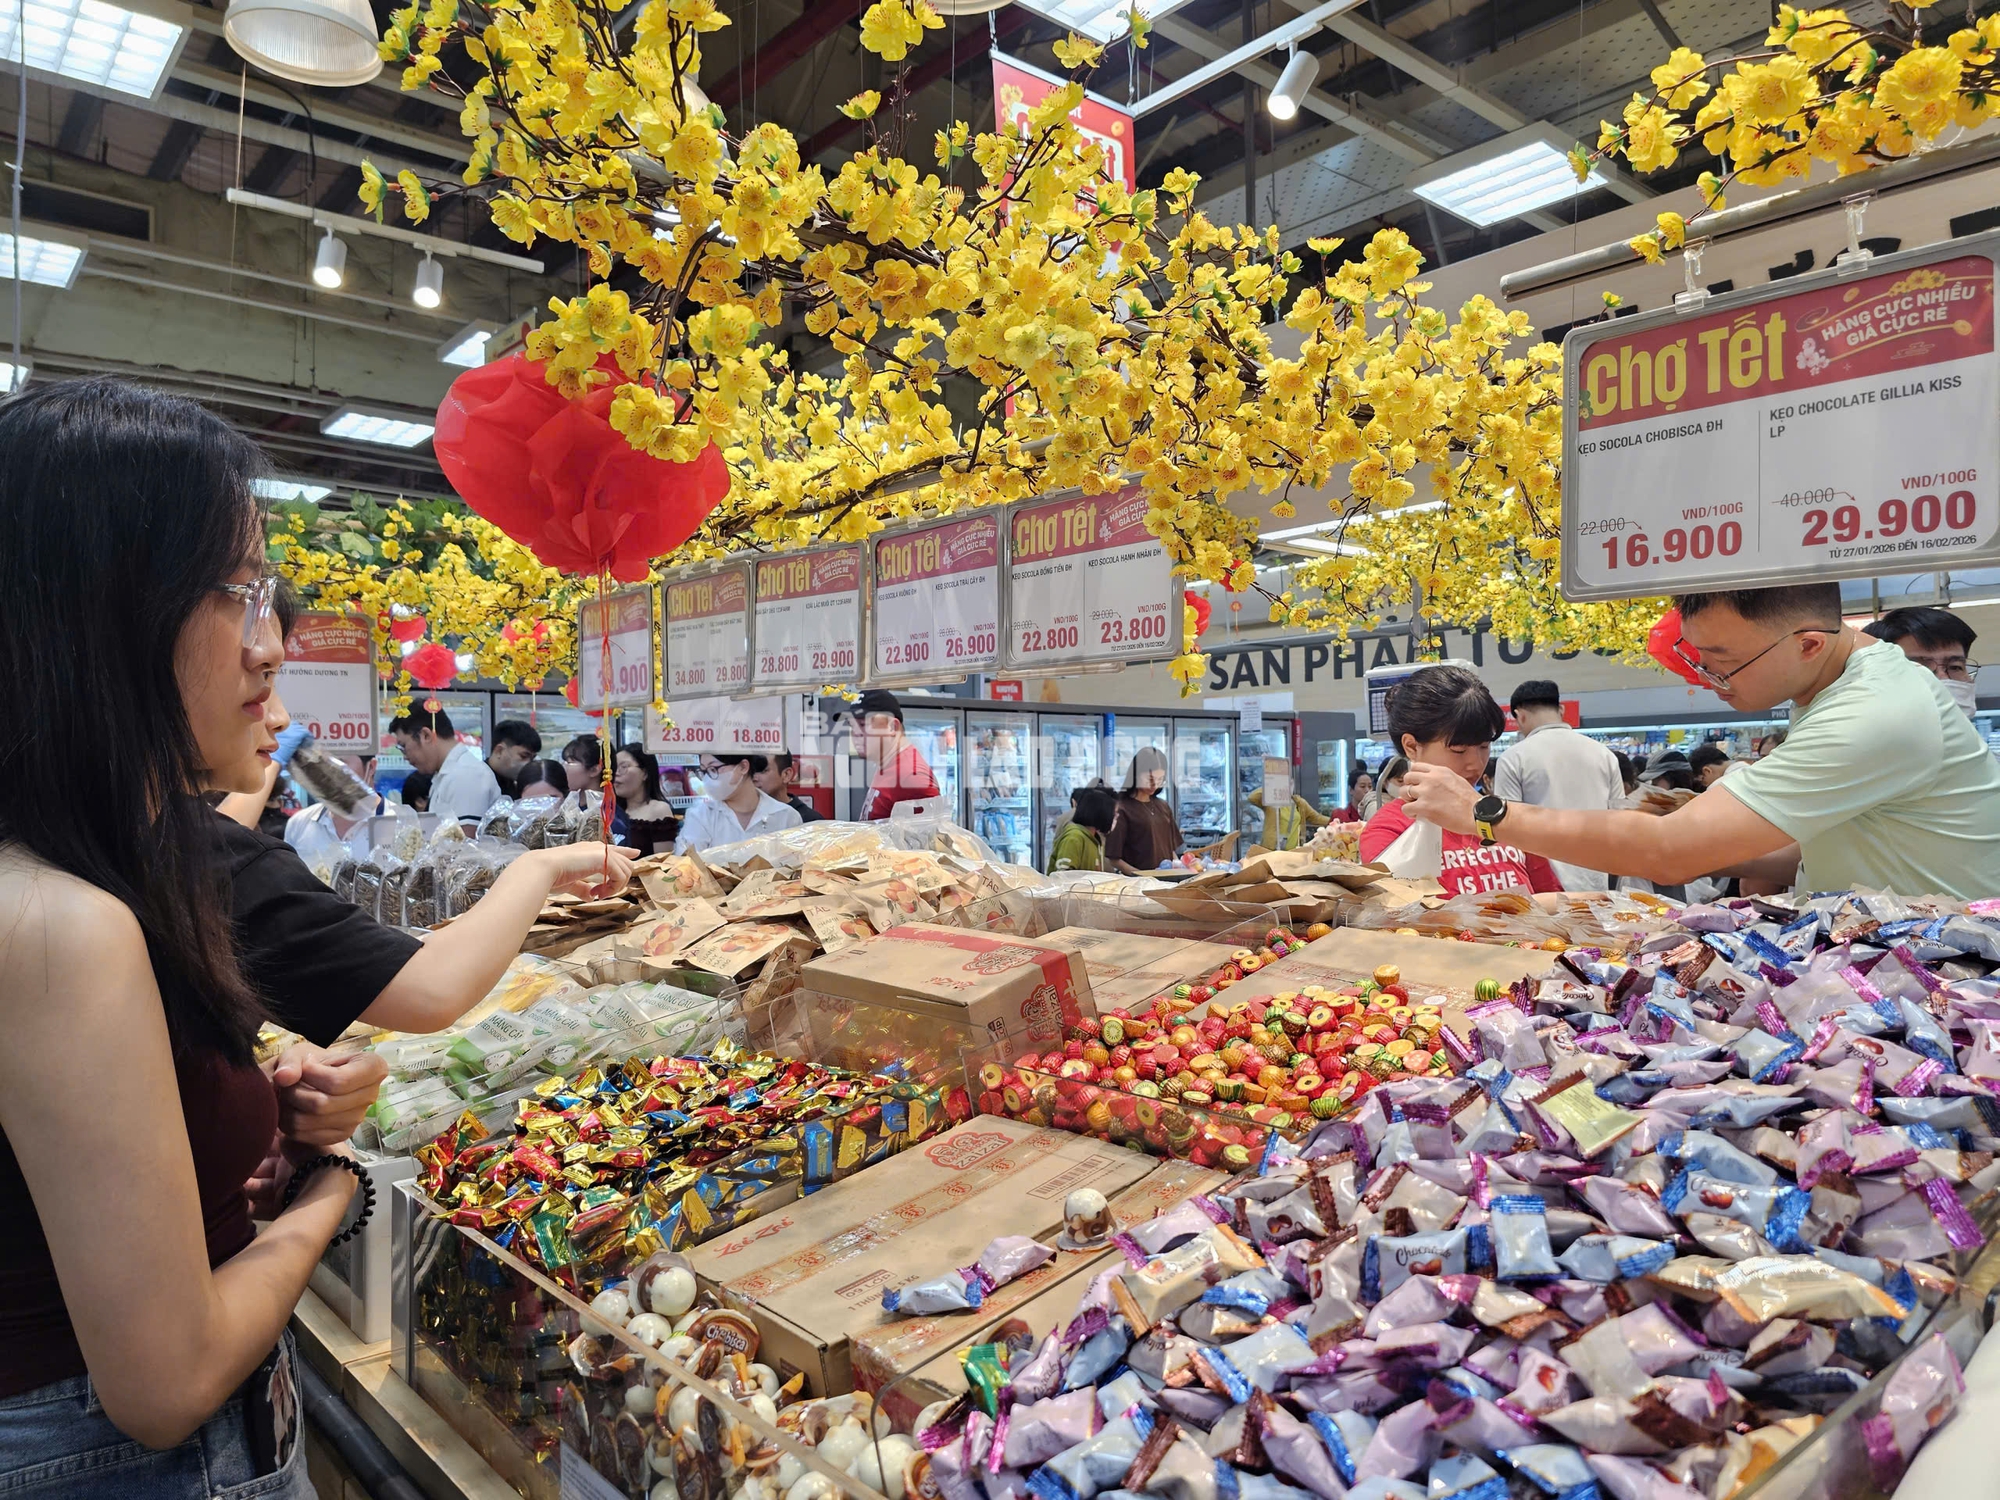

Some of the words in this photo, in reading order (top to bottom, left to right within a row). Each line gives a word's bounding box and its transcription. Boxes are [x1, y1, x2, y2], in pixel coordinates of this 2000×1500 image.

[1821, 311, 1871, 341] HÀNG
[1873, 295, 1914, 321] CỰC
[1914, 282, 1976, 308] NHIỀU
[1847, 324, 1878, 346] GIÁ
[1880, 317, 1921, 343] CỰC
[1923, 304, 1949, 326] RẺ
[1587, 336, 1687, 417] Chợ
[1699, 311, 1786, 393] Tết
[1769, 408, 1794, 424] KẸO
[1798, 390, 1876, 416] CHOCOLATE
[1880, 382, 1926, 402] GILLIA
[1929, 376, 1963, 394] KISS
[1599, 434, 1643, 452] SOCOLA
[1645, 422, 1703, 444] CHOBISCA
[1706, 419, 1724, 433] ĐH
[1769, 425, 1786, 438] LP
[1901, 468, 1978, 491] VND/100G
[1779, 487, 1835, 508] 40.000
[1109, 506, 1129, 522] HÀNG
[1130, 501, 1144, 514] CỰC
[1118, 516, 1130, 527] GIÁ
[1131, 511, 1145, 524] CỰC
[1682, 502, 1744, 521] VND/100G
[1802, 490, 1977, 547] 29.900
[1017, 513, 1058, 556] Chợ
[1062, 502, 1097, 548] Tết
[950, 538, 965, 550] HÀNG
[1602, 521, 1742, 570] 16.900
[1829, 546, 1843, 559] TỪ
[1844, 541, 1896, 558] 27/01/2026
[1898, 535, 1918, 553] ĐẾN
[1920, 534, 1977, 550] 16/02/2026
[882, 543, 912, 581] Chợ
[915, 532, 941, 573] Tết
[1099, 556, 1120, 566] SOCOLA
[759, 563, 786, 599] Chợ
[788, 557, 810, 592] Tết
[1137, 603, 1166, 613] VND/100G
[1054, 615, 1078, 624] VND/100G
[1100, 615, 1166, 644] 23.800
[300, 631, 323, 641] HÀNG
[326, 630, 343, 639] CỰC
[312, 638, 326, 646] GIÁ
[946, 633, 995, 658] 26.900
[1022, 626, 1078, 652] 22.800
[761, 654, 798, 673] 28.800
[813, 649, 854, 670] 29.900
[886, 641, 929, 664] 22.900
[675, 668, 705, 686] 34.800
[716, 664, 747, 682] 29.800
[662, 728, 714, 742] 23.800
[733, 729, 780, 743] 18.800
[1457, 877, 1477, 895] IS
[1480, 871, 1518, 892] THE
